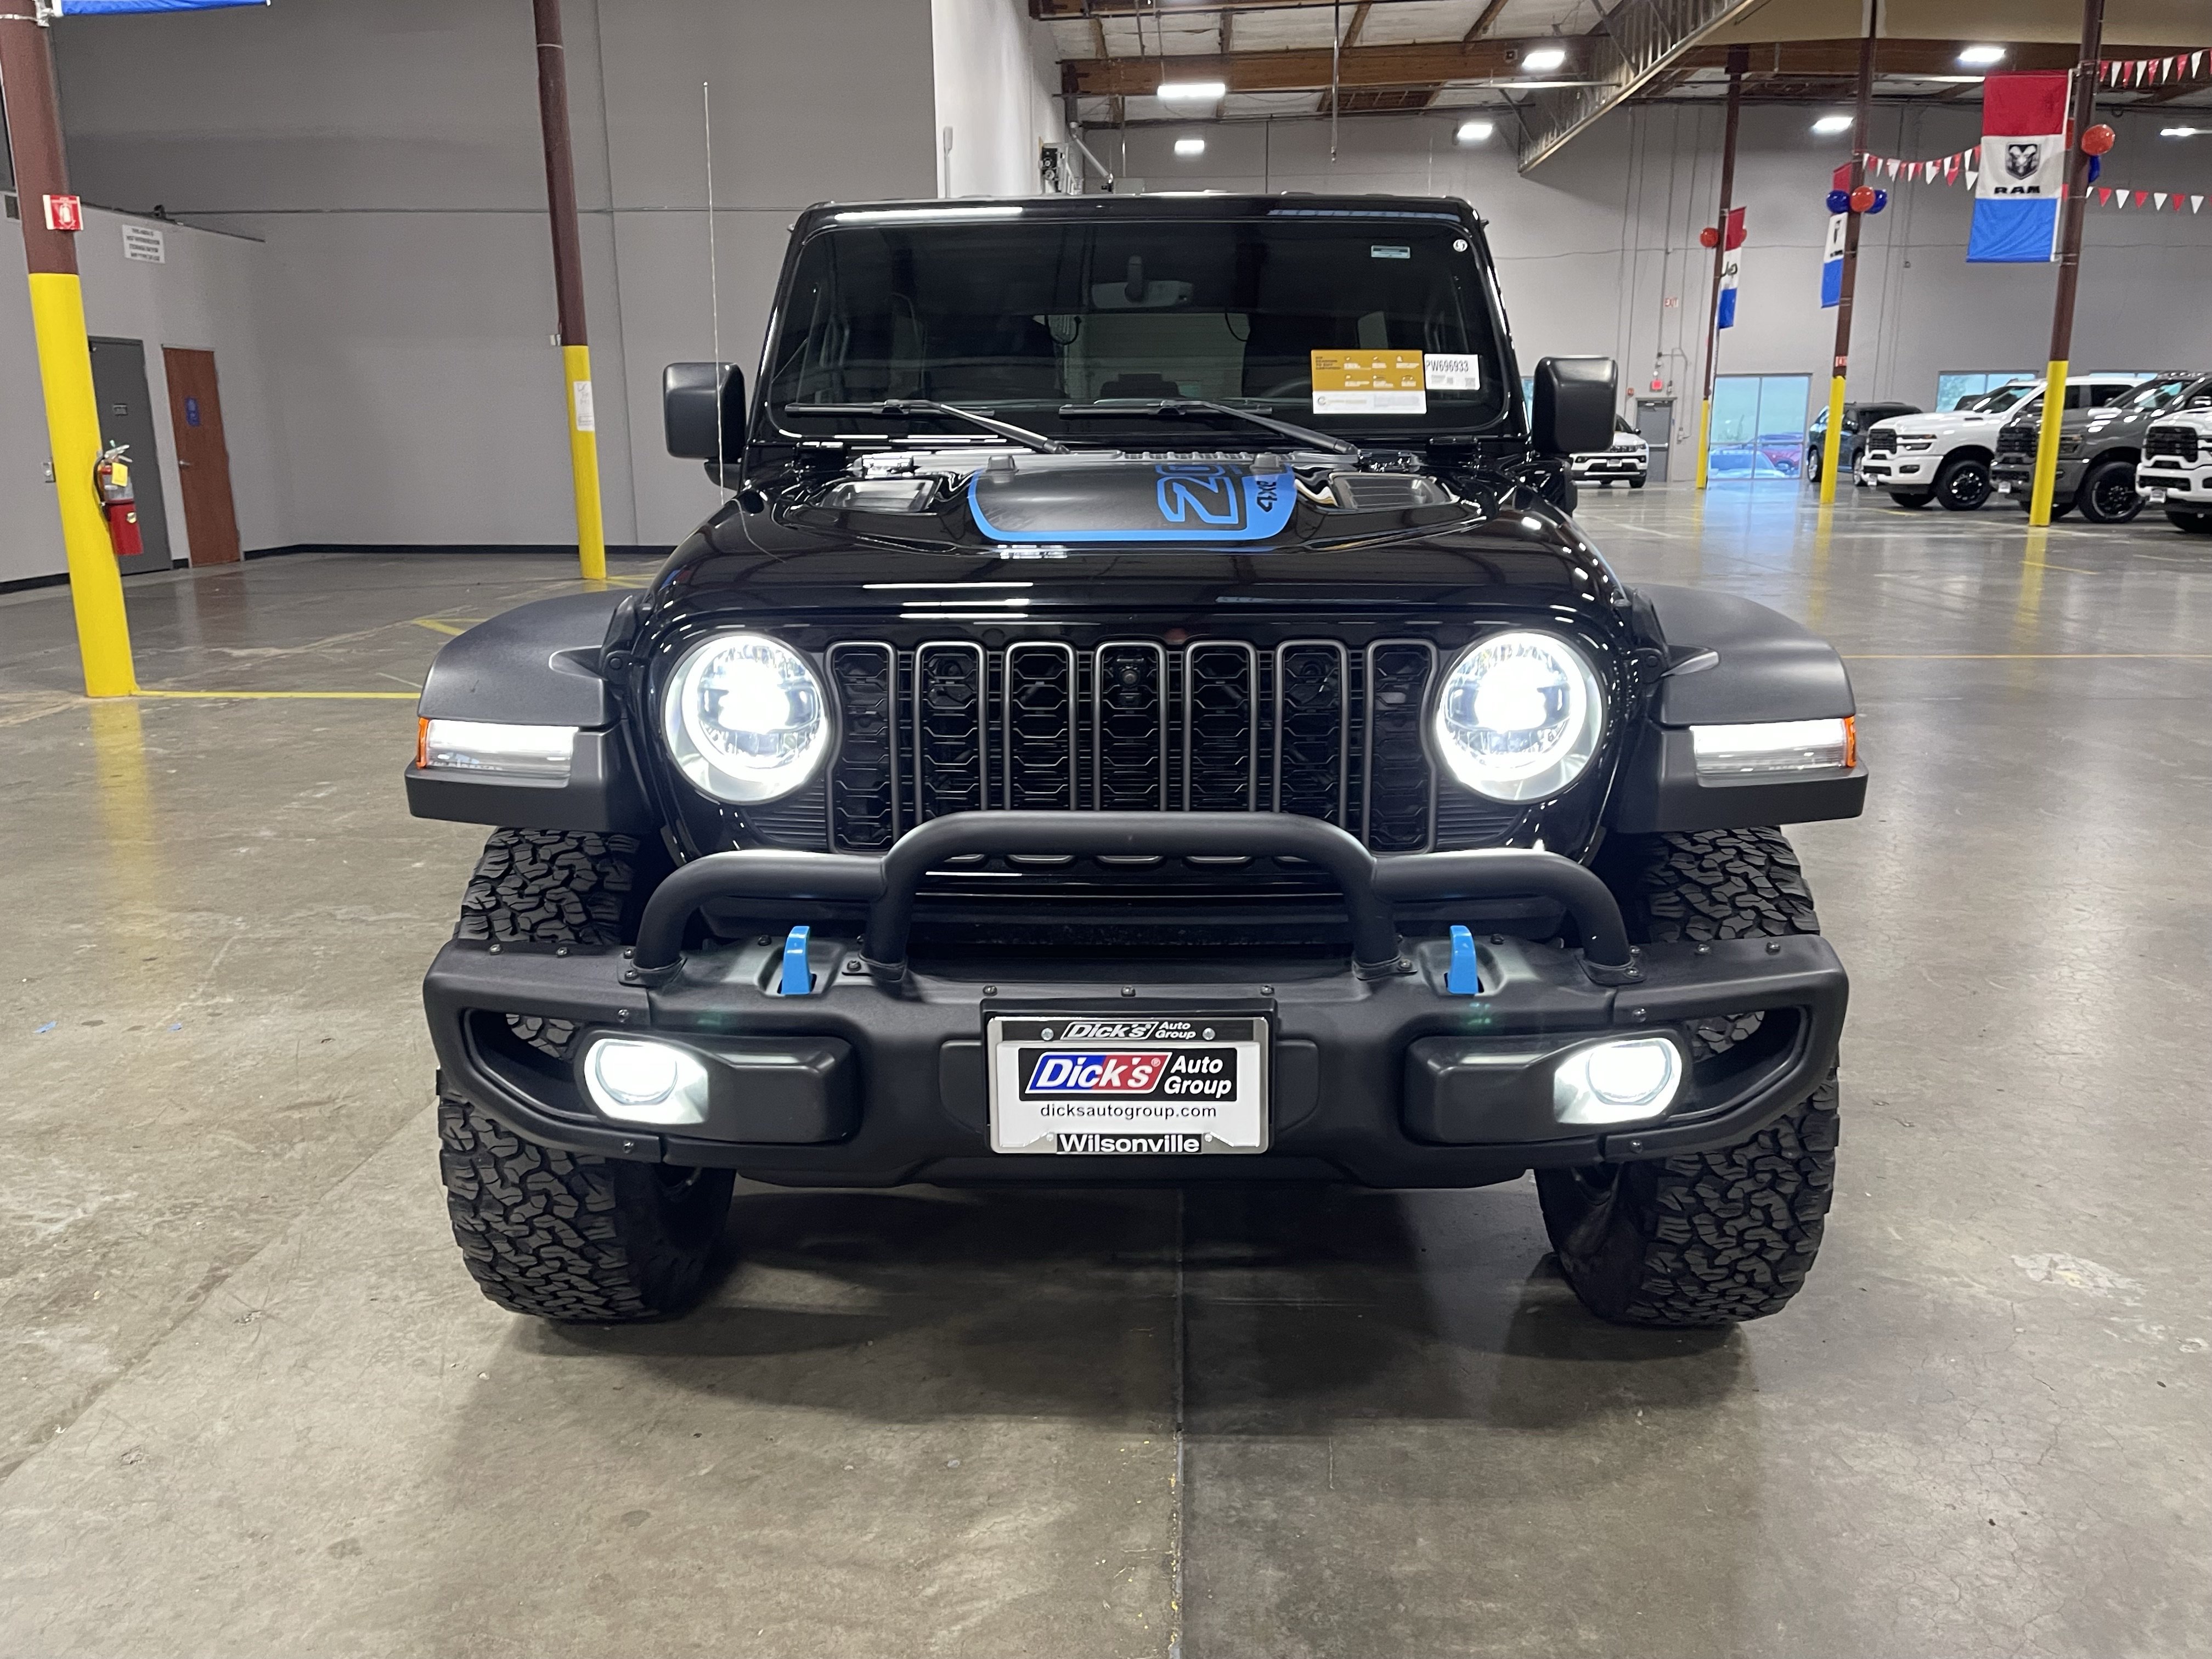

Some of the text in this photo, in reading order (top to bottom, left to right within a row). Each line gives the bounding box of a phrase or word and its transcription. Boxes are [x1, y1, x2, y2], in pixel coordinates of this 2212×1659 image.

[1994, 185, 2040, 194] RAM
[1425, 360, 1469, 373] PW696933
[1067, 1023, 1147, 1037] Dick's
[1159, 1022, 1191, 1030] Auto
[1155, 1030, 1197, 1040] Group
[1170, 1056, 1223, 1074] Auto
[1036, 1057, 1153, 1088] Dick's
[1164, 1076, 1232, 1098] Group
[1040, 1104, 1217, 1119] dicksautogroup.com
[1059, 1134, 1200, 1153] Wilsonville
